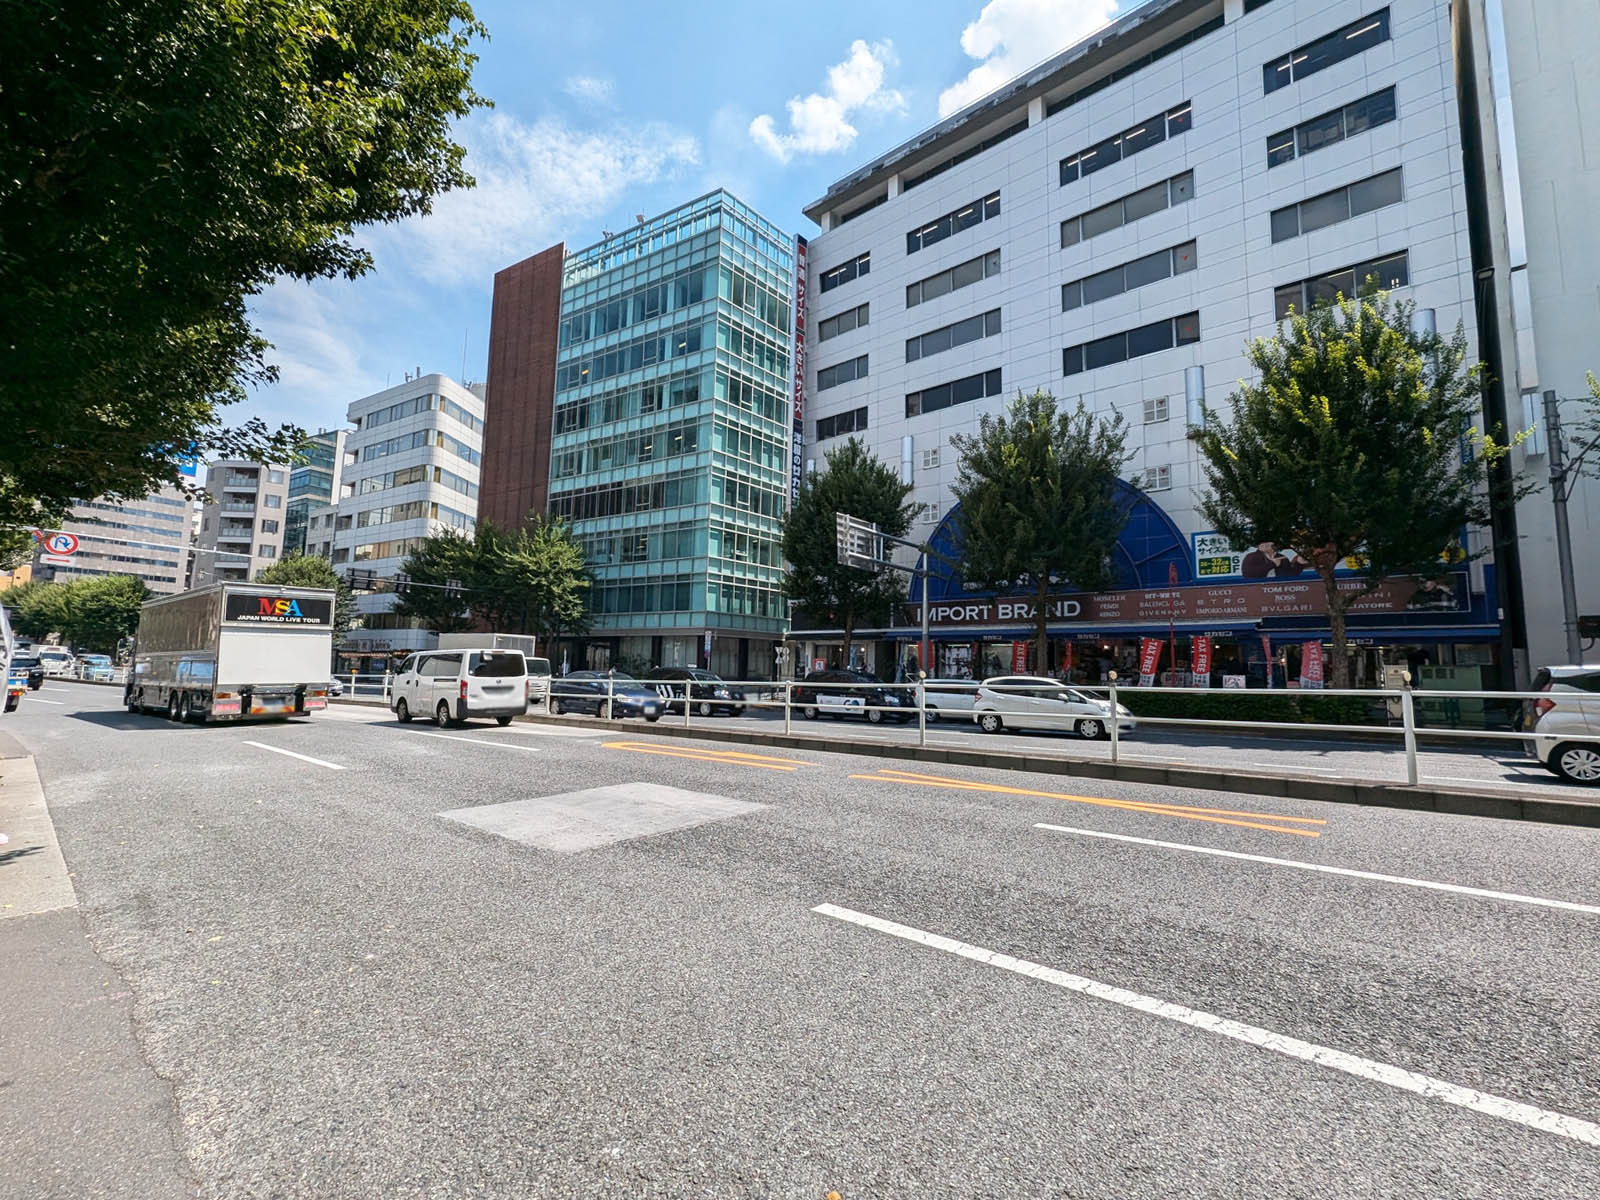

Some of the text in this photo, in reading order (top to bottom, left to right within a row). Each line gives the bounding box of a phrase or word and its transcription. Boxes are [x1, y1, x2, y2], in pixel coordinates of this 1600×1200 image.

[1197, 537, 1228, 548] 大きい
[257, 597, 303, 617] MSA
[916, 604, 993, 623] IMPORT
[1261, 604, 1313, 612] BVLGARI
[1147, 640, 1158, 655] TAX
[1197, 638, 1207, 653] TAX
[1142, 655, 1154, 673] FREE
[1197, 654, 1207, 673] FREE
